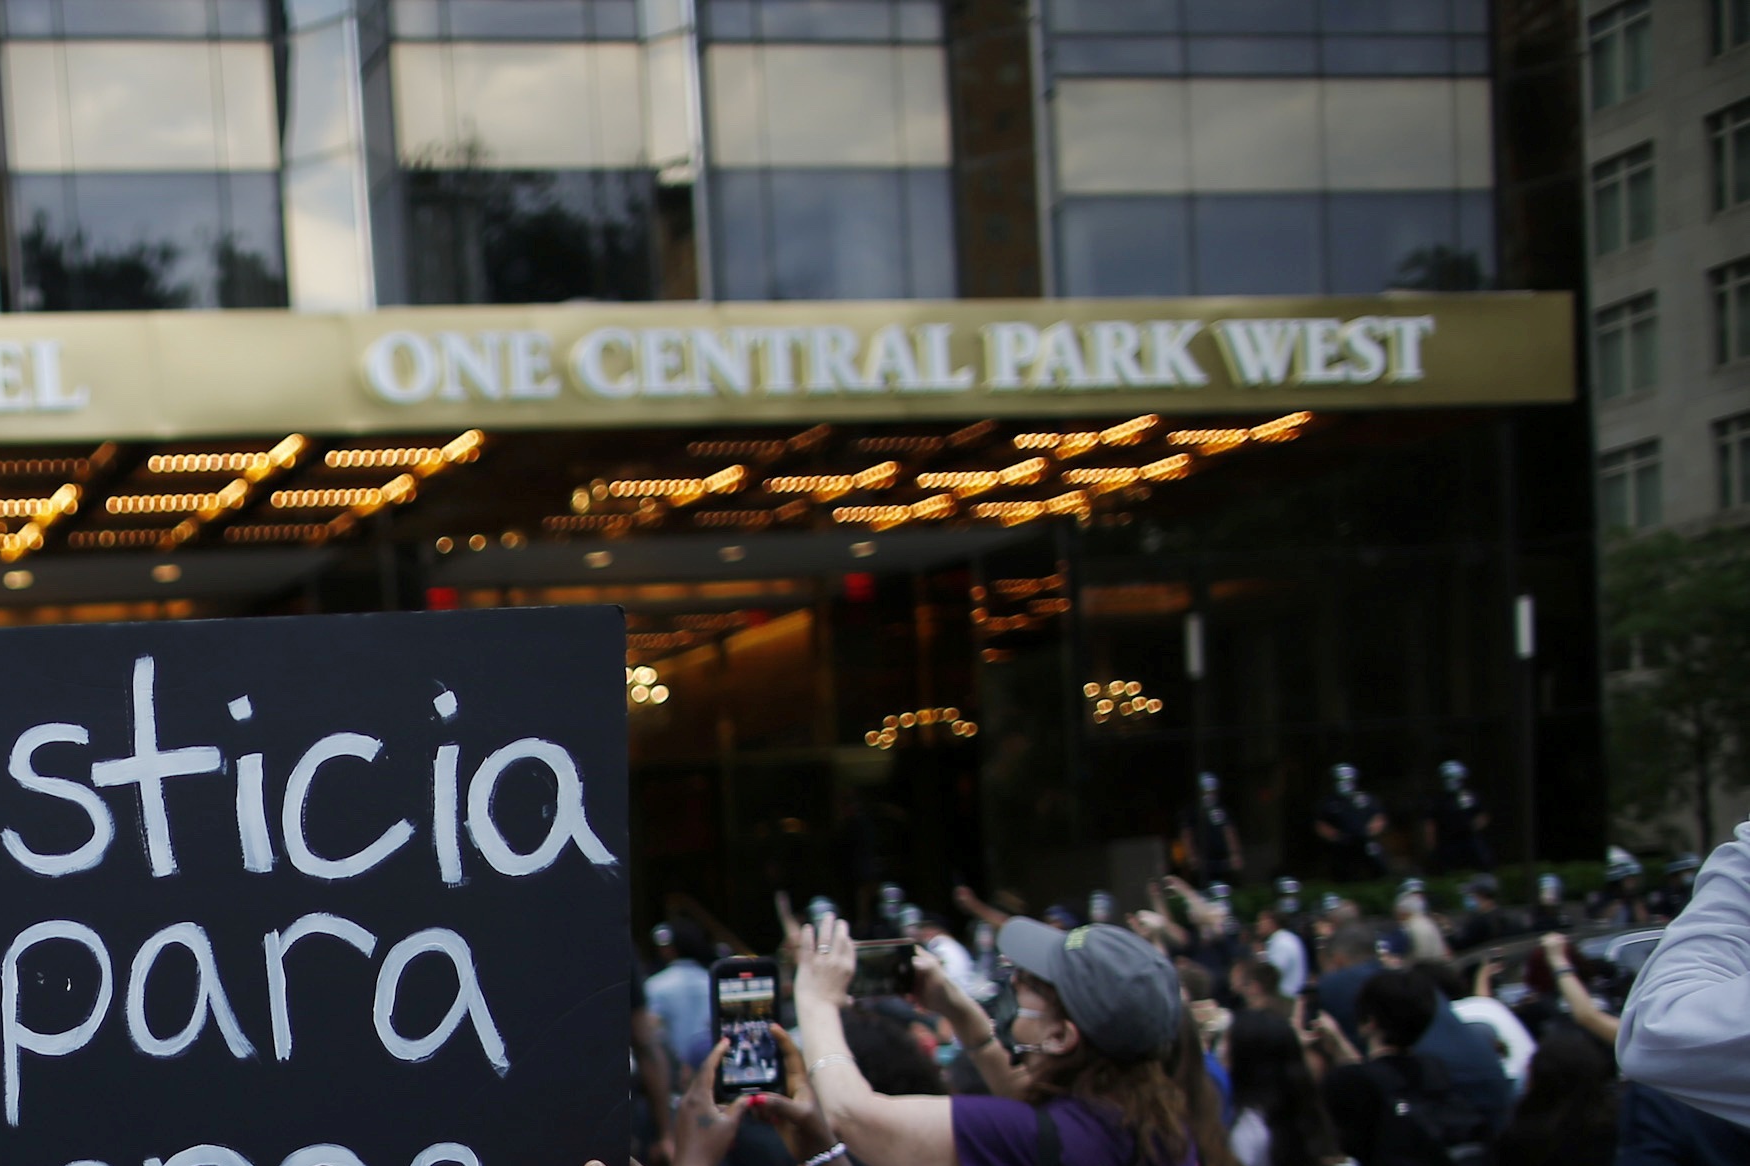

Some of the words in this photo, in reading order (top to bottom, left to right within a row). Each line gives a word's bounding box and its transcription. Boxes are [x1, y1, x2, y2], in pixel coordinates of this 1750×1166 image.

[364, 324, 558, 404] ONE
[569, 318, 971, 398] CENTRAL
[982, 316, 1208, 390] PARK
[1220, 313, 1434, 385] WEST
[0, 912, 509, 1126] para
